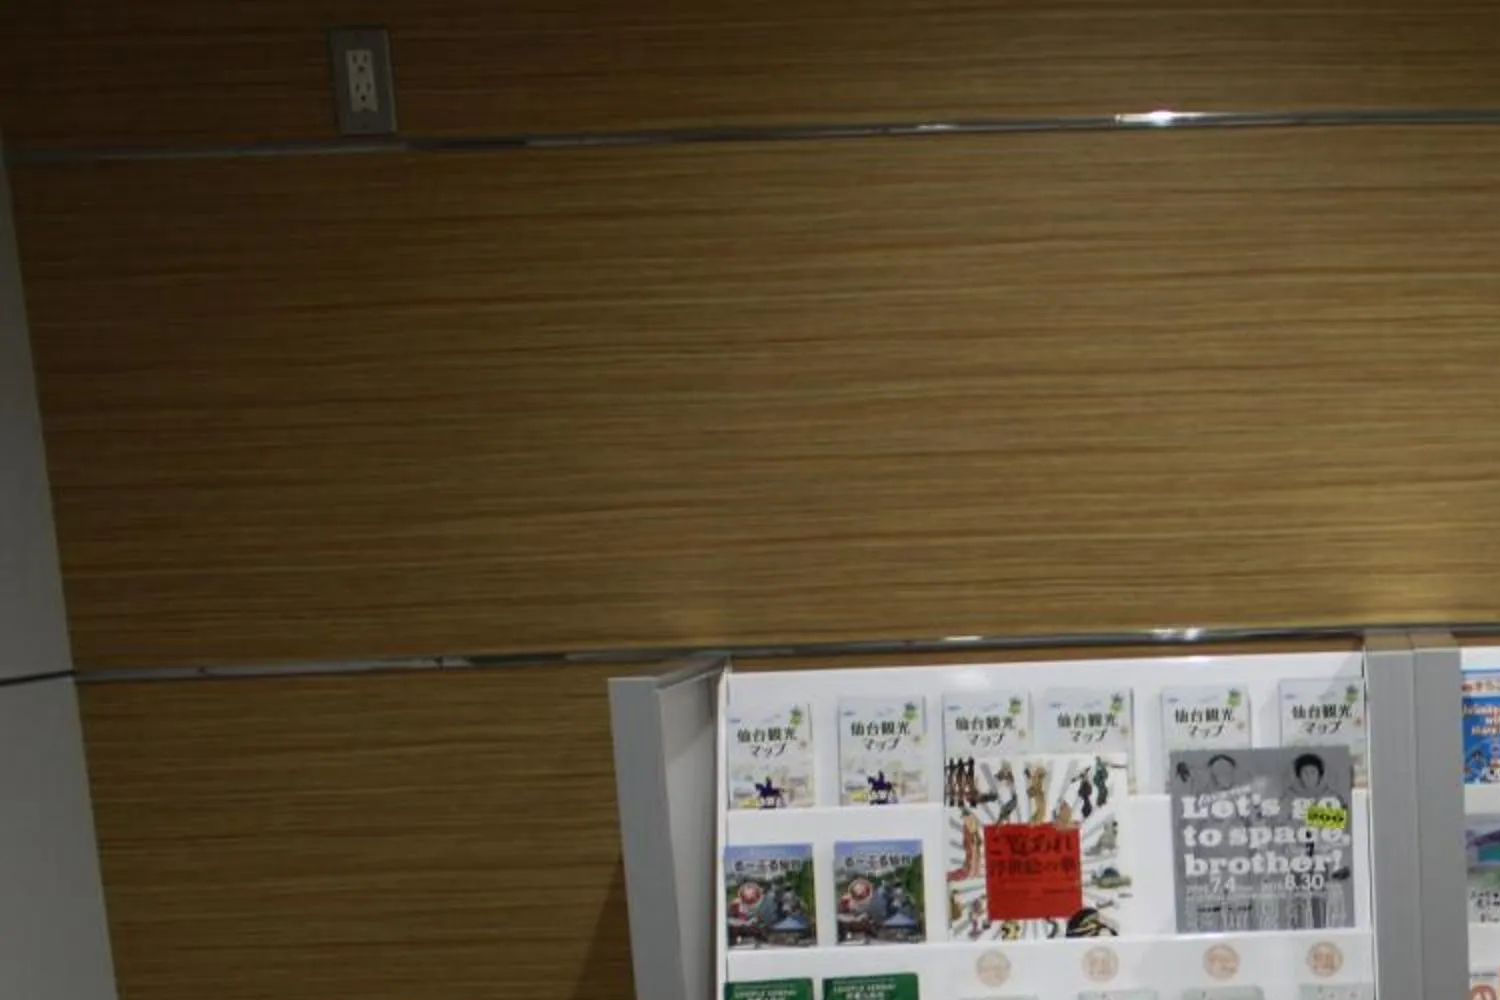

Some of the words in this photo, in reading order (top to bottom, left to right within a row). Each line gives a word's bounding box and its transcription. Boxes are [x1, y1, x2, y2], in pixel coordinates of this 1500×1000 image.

[1175, 707, 1236, 724] 仙台観光
[1292, 703, 1353, 719] 仙台観光
[850, 720, 911, 736] 仙台観光
[955, 715, 1017, 732] 仙台観光
[1057, 712, 1119, 728] 仙台観光
[1303, 719, 1343, 736] マップ
[737, 727, 798, 743] 仙台観光
[1070, 729, 1108, 744] マップ
[1187, 723, 1226, 739] マップ
[863, 736, 902, 752] マップ
[968, 731, 1006, 748] マップ
[750, 742, 787, 758] マップ
[1181, 793, 1281, 819] Let's
[1183, 825, 1222, 847] to
[1184, 850, 1344, 877] brother!
